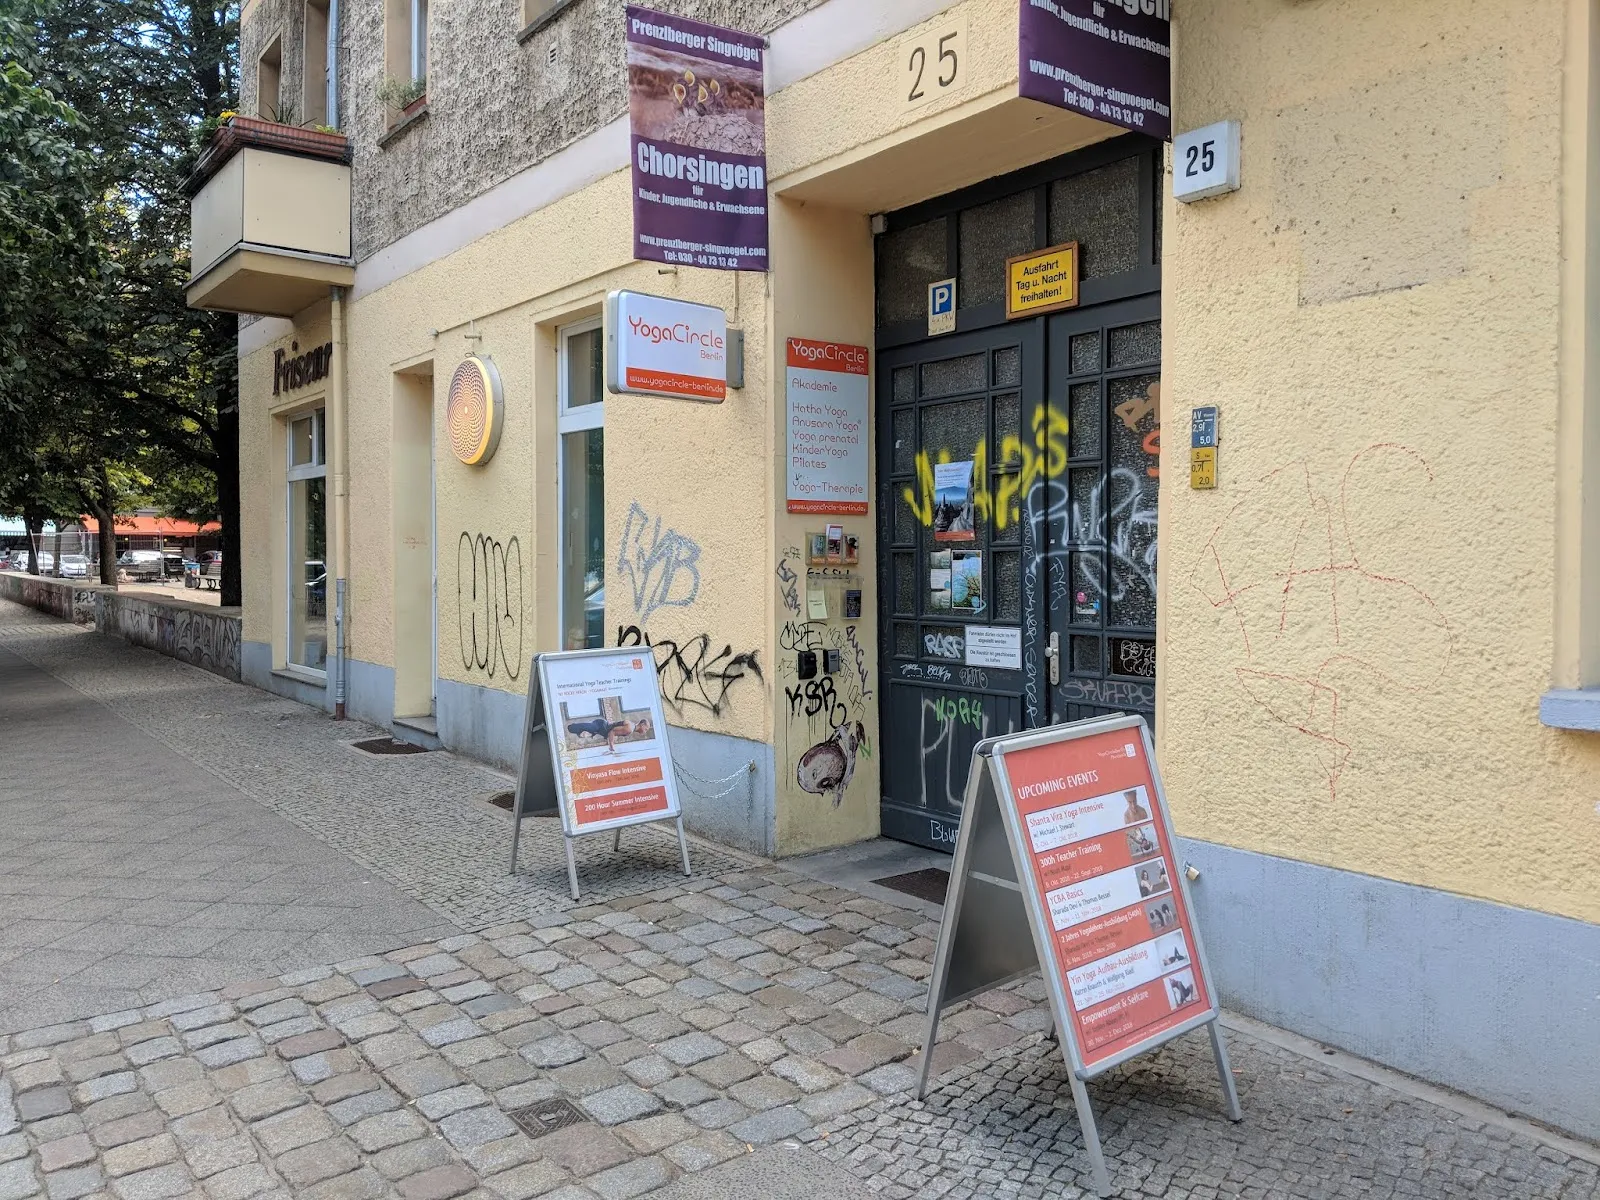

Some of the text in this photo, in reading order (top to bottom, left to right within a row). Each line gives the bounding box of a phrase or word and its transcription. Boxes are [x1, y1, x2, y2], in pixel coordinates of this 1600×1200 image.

[1093, 1, 1105, 18] für
[1061, 6, 1110, 39] Jugendliche
[1111, 29, 1118, 42] &
[1119, 30, 1170, 58] Erwachsene
[908, 31, 958, 102] 25
[1029, 59, 1170, 118] www.prenzlberger-singvoegel.com
[1063, 88, 1079, 105] Tel:
[1079, 94, 1095, 112] 030
[1100, 101, 1111, 116] 44
[1111, 106, 1122, 121] 73
[1122, 109, 1132, 124] 13
[1133, 112, 1144, 127] 42
[637, 142, 764, 190] Chorsingen
[1186, 139, 1215, 178] 25
[692, 185, 704, 196] für
[638, 187, 765, 215] Kinder, Jugendliche & Erwachsene
[639, 234, 767, 257] www.prenzlberger-singvoegel.com
[664, 250, 678, 261] Tel:
[678, 252, 693, 264] 030
[698, 255, 708, 265] 44
[708, 256, 718, 266] 73
[718, 256, 727, 267] 13
[727, 257, 738, 267] 42
[1023, 260, 1059, 276] Ausfahrt
[1016, 272, 1067, 291] Tag u. Nacht
[1020, 286, 1062, 303] freihalten!
[628, 315, 723, 349] YogaCircle
[700, 350, 724, 361] Berlin
[791, 340, 865, 364] YogaCircle
[846, 364, 865, 373] Berlin
[629, 375, 724, 394] www.yogacircle-berlin.de
[792, 378, 838, 392] Akademie
[792, 402, 848, 418] Hatha Yoga
[792, 416, 833, 429] Anusara
[792, 430, 859, 445] Yoga prenatal
[1200, 436, 1210, 445] 5,0
[792, 443, 848, 458] KinderYoga
[793, 457, 827, 469] Pilates
[793, 481, 864, 495] Yoga-Therapie
[1199, 477, 1210, 485] 2,0
[586, 770, 607, 780] Vinyasa
[608, 768, 620, 776] Flow
[621, 765, 646, 773] Intensive
[1017, 770, 1099, 799] UPCOMING EVENTS
[584, 803, 595, 811] 200
[596, 801, 610, 809] Hour
[611, 797, 633, 807] Summer
[634, 793, 658, 802] Intensive
[1029, 801, 1104, 827] Shanta Vira Yoga Intensive
[1039, 826, 1055, 836] Michael
[1059, 821, 1074, 831] Stewart
[1039, 841, 1102, 867] 300h Teacher Training
[1066, 887, 1083, 900] Basics
[1070, 947, 1148, 985] Yin Yoga Aufbau-Ausbildung
[1081, 1000, 1122, 1026] Empowerment
[1121, 998, 1127, 1007] &
[1127, 988, 1149, 1005] Selfcare
